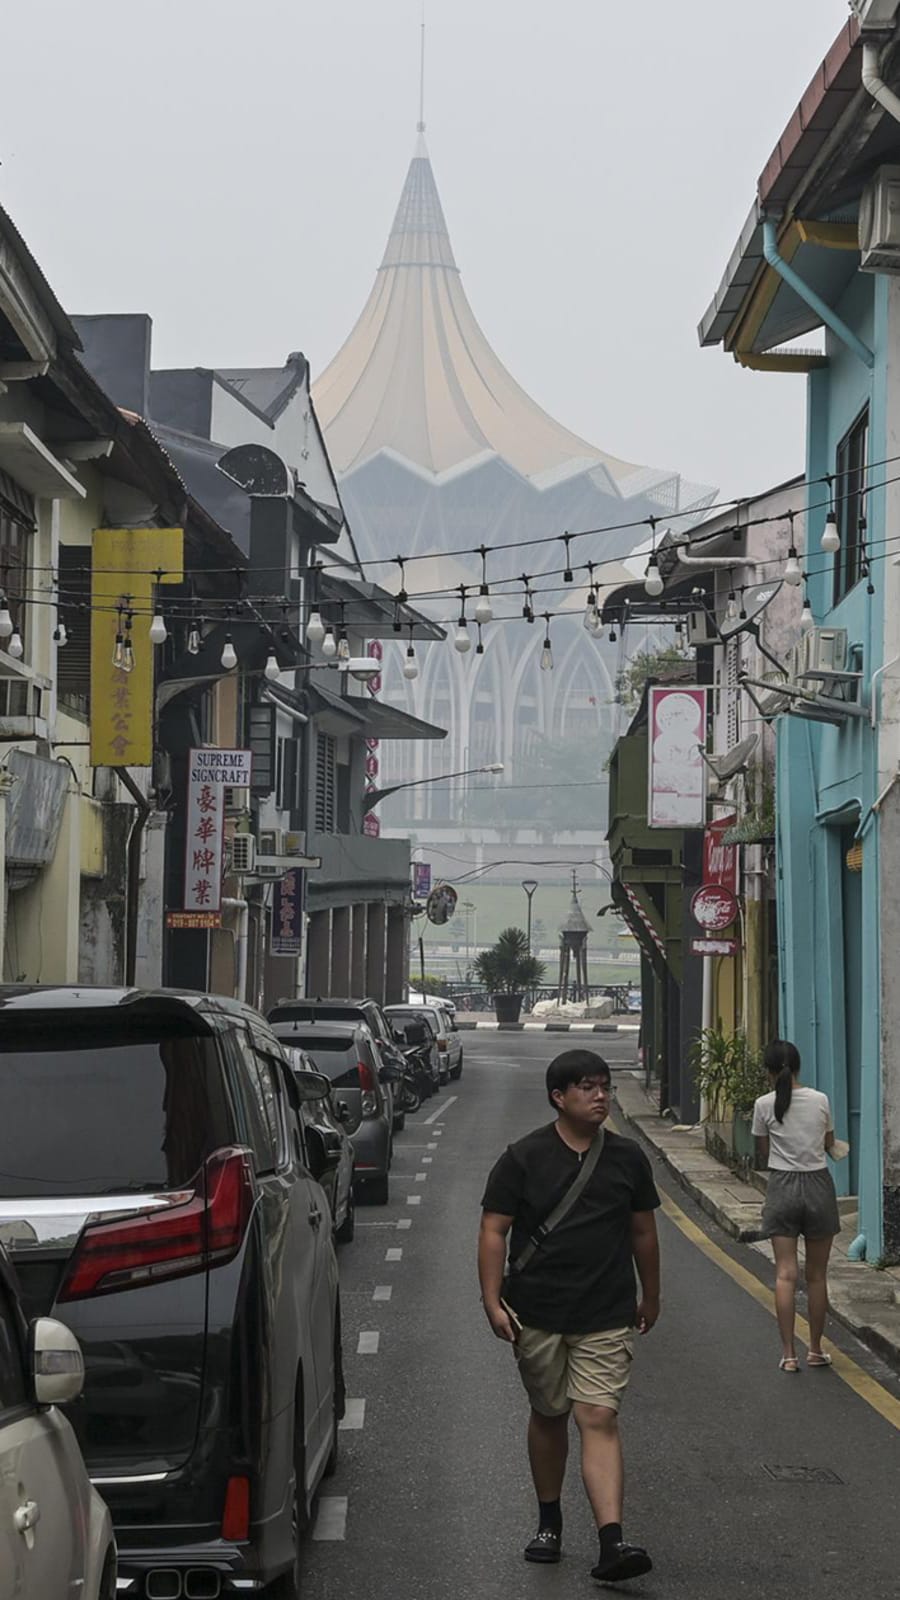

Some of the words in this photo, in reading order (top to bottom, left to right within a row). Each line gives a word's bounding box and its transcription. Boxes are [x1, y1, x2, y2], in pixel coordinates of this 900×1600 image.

[197, 753, 244, 767] SUPREME
[191, 769, 249, 783] SIGNCRAFT
[192, 785, 217, 905] 豪華牌業
